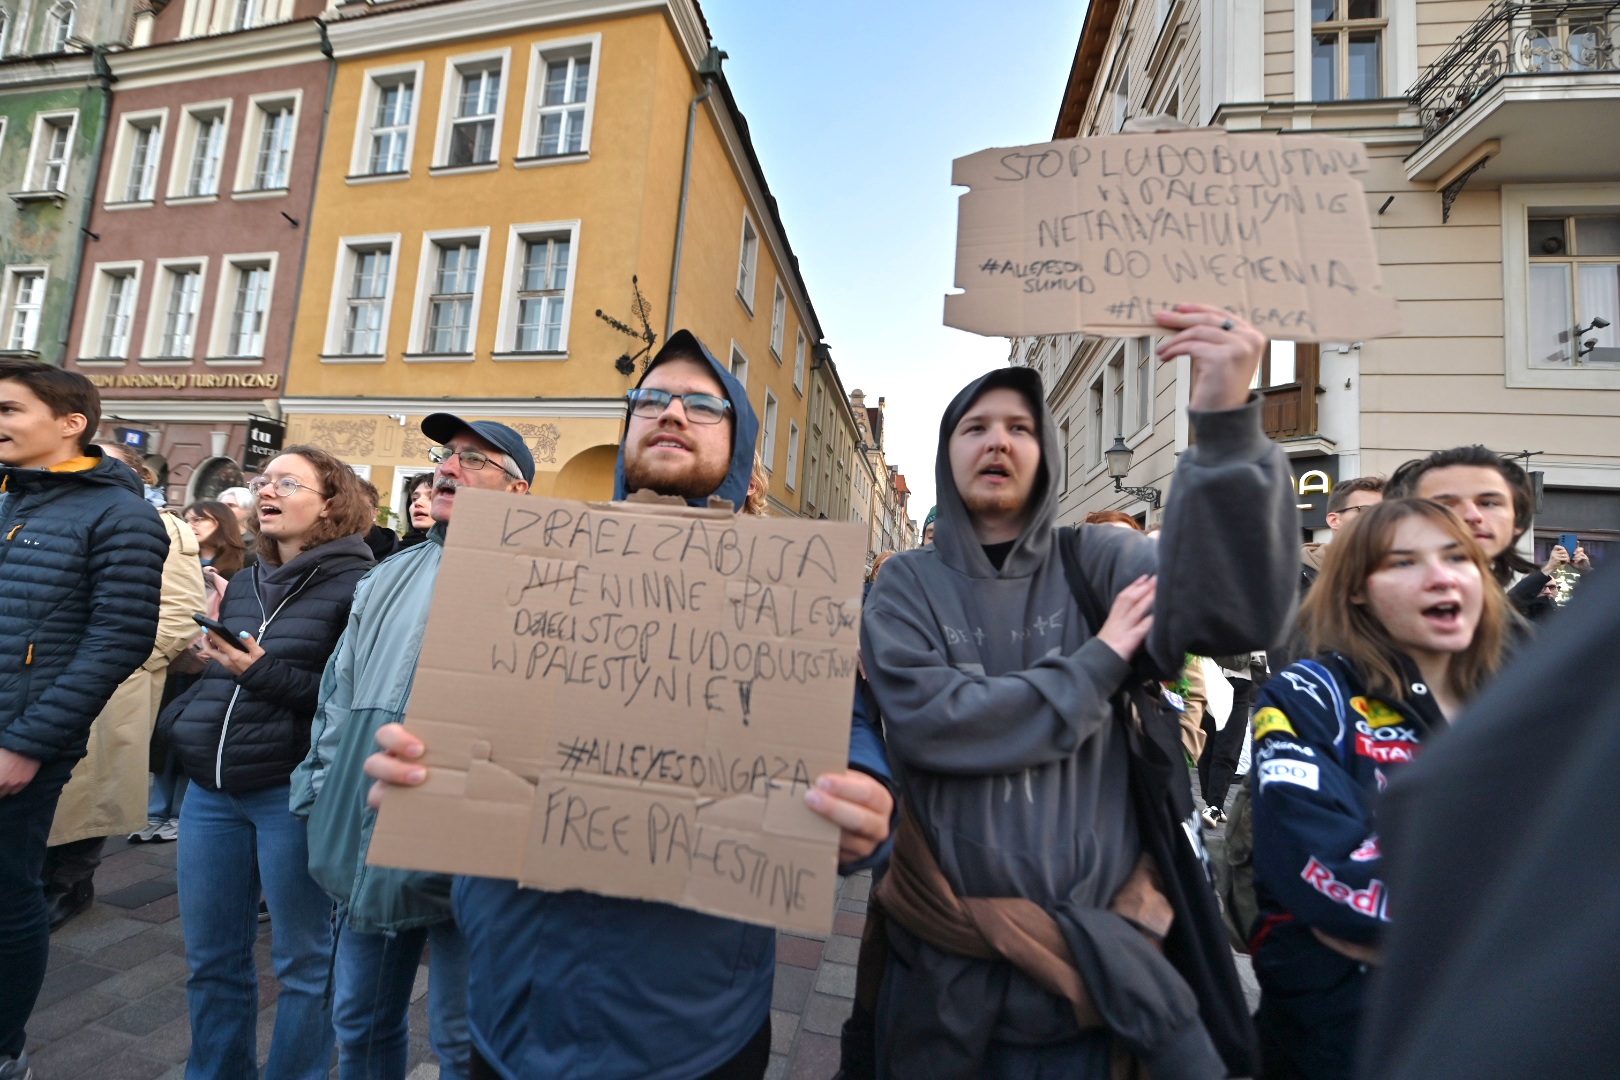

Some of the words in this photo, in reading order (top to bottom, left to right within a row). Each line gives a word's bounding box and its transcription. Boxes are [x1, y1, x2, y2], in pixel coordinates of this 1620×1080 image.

[995, 144, 1091, 181] STOP
[1140, 177, 1349, 224] PALESTYNIE
[1104, 247, 1150, 280] DO
[251, 427, 271, 444] tu
[500, 508, 641, 558] IZRAEL
[652, 518, 838, 584] ZABIJA
[492, 641, 517, 674] W
[581, 613, 660, 664] STOP
[557, 736, 812, 797] #ALLEYESONGAZA
[541, 787, 630, 855] FREE
[648, 802, 815, 914] PALESTINE
[1300, 855, 1381, 918] Red
